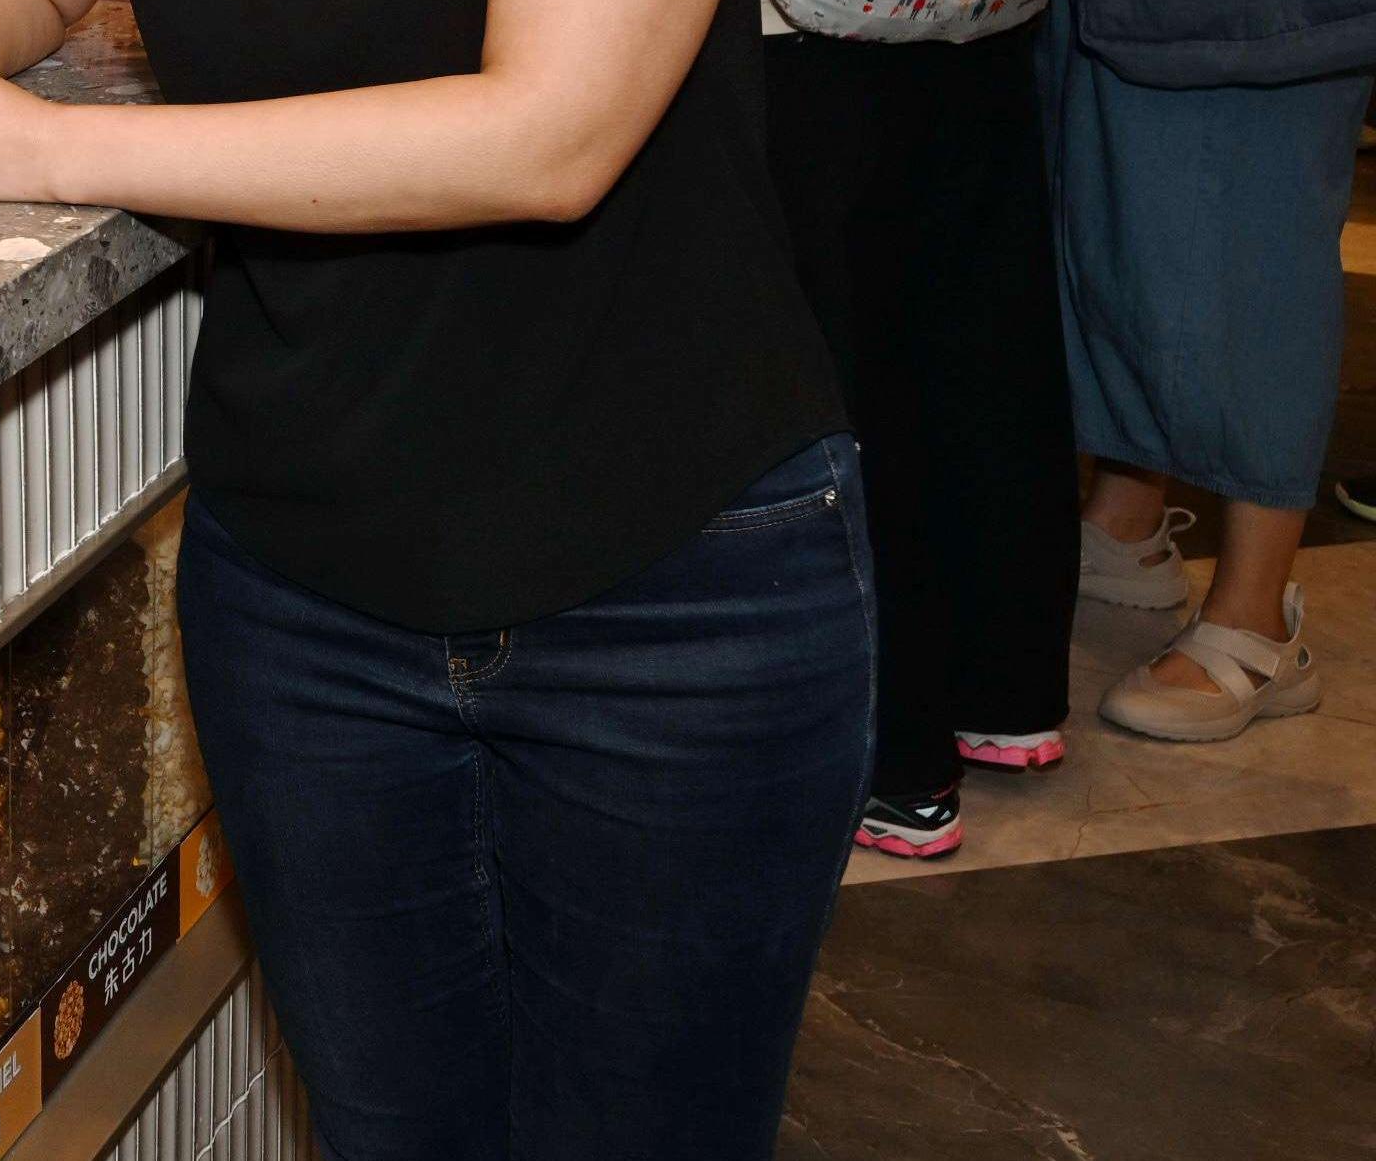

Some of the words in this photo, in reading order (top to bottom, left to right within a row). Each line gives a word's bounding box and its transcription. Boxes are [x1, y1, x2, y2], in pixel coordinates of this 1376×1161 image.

[88, 870, 168, 980] CHOCOLATE
[104, 927, 152, 1007] 朱古力
